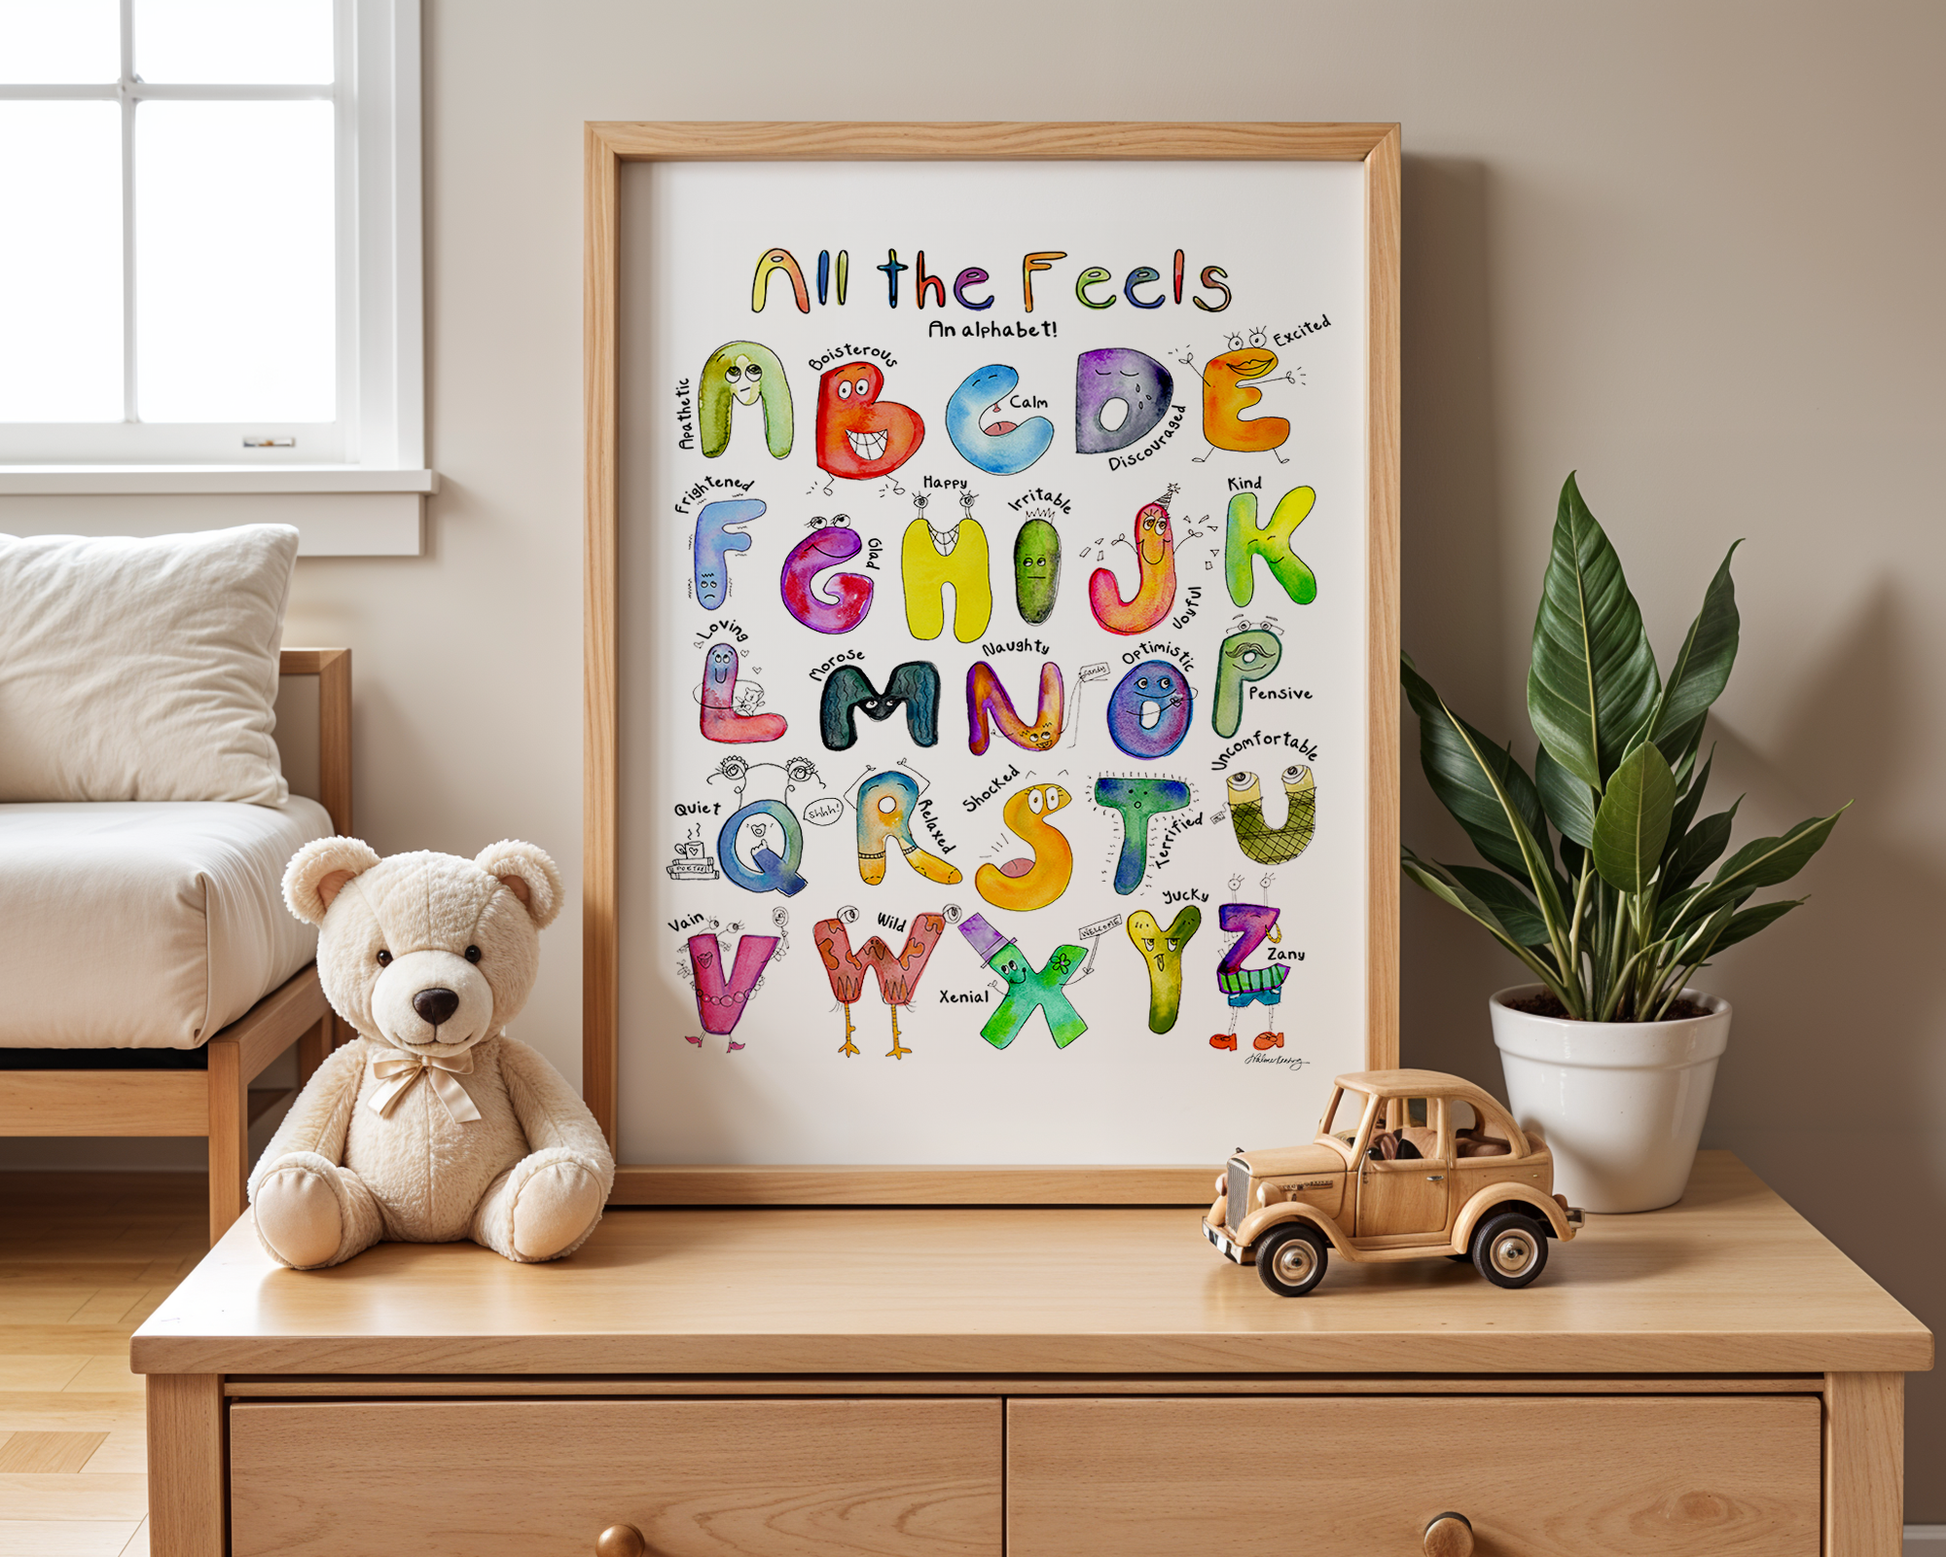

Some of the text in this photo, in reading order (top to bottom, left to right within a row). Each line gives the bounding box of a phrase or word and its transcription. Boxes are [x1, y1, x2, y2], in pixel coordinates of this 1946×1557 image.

[752, 248, 1232, 314] All the Feels
[807, 342, 898, 372] Boisterous
[928, 320, 1057, 339] An alphabet!
[1273, 313, 1332, 347] Excited
[675, 378, 695, 450] Apathetic
[816, 361, 926, 480] B
[945, 364, 1054, 475] C
[1009, 394, 1049, 410] Calm
[1075, 347, 1174, 454] D
[1203, 347, 1291, 452] E
[1107, 403, 1187, 471] Discouraged
[674, 475, 756, 514] Frightened
[923, 475, 968, 490] Happy
[1007, 487, 1072, 515] Irritable
[1227, 476, 1263, 491] Kind
[694, 498, 767, 611] F
[865, 537, 884, 570] Glad
[1088, 502, 1177, 636] J
[1225, 485, 1318, 608] K
[780, 526, 874, 634] G
[901, 518, 993, 644] H
[1172, 586, 1202, 631] Joyful
[695, 619, 749, 643] Loving
[981, 637, 1051, 658] Naughty
[1121, 640, 1195, 674] Optimistic
[700, 643, 788, 744] L
[808, 648, 867, 682] Morose
[1212, 629, 1282, 739] P
[1249, 686, 1313, 700] Pensive
[820, 661, 941, 752] M
[966, 660, 1065, 757] N
[1211, 730, 1319, 772] Uncomfortable
[674, 800, 722, 817] Quiet
[962, 763, 1021, 813] Shocked
[1226, 765, 1317, 866] U
[857, 770, 963, 886] R
[917, 798, 957, 856] Relaxed
[975, 783, 1073, 912] S
[1094, 777, 1191, 896] T
[1155, 811, 1204, 870] Terrified
[667, 912, 705, 933] Vain
[877, 912, 907, 933] Wild
[1217, 903, 1291, 995] Z
[687, 933, 781, 1036] V
[812, 911, 947, 1006] W
[1126, 904, 1202, 1035] Y
[1266, 947, 1306, 962] Zany
[939, 989, 989, 1004] Xenial
